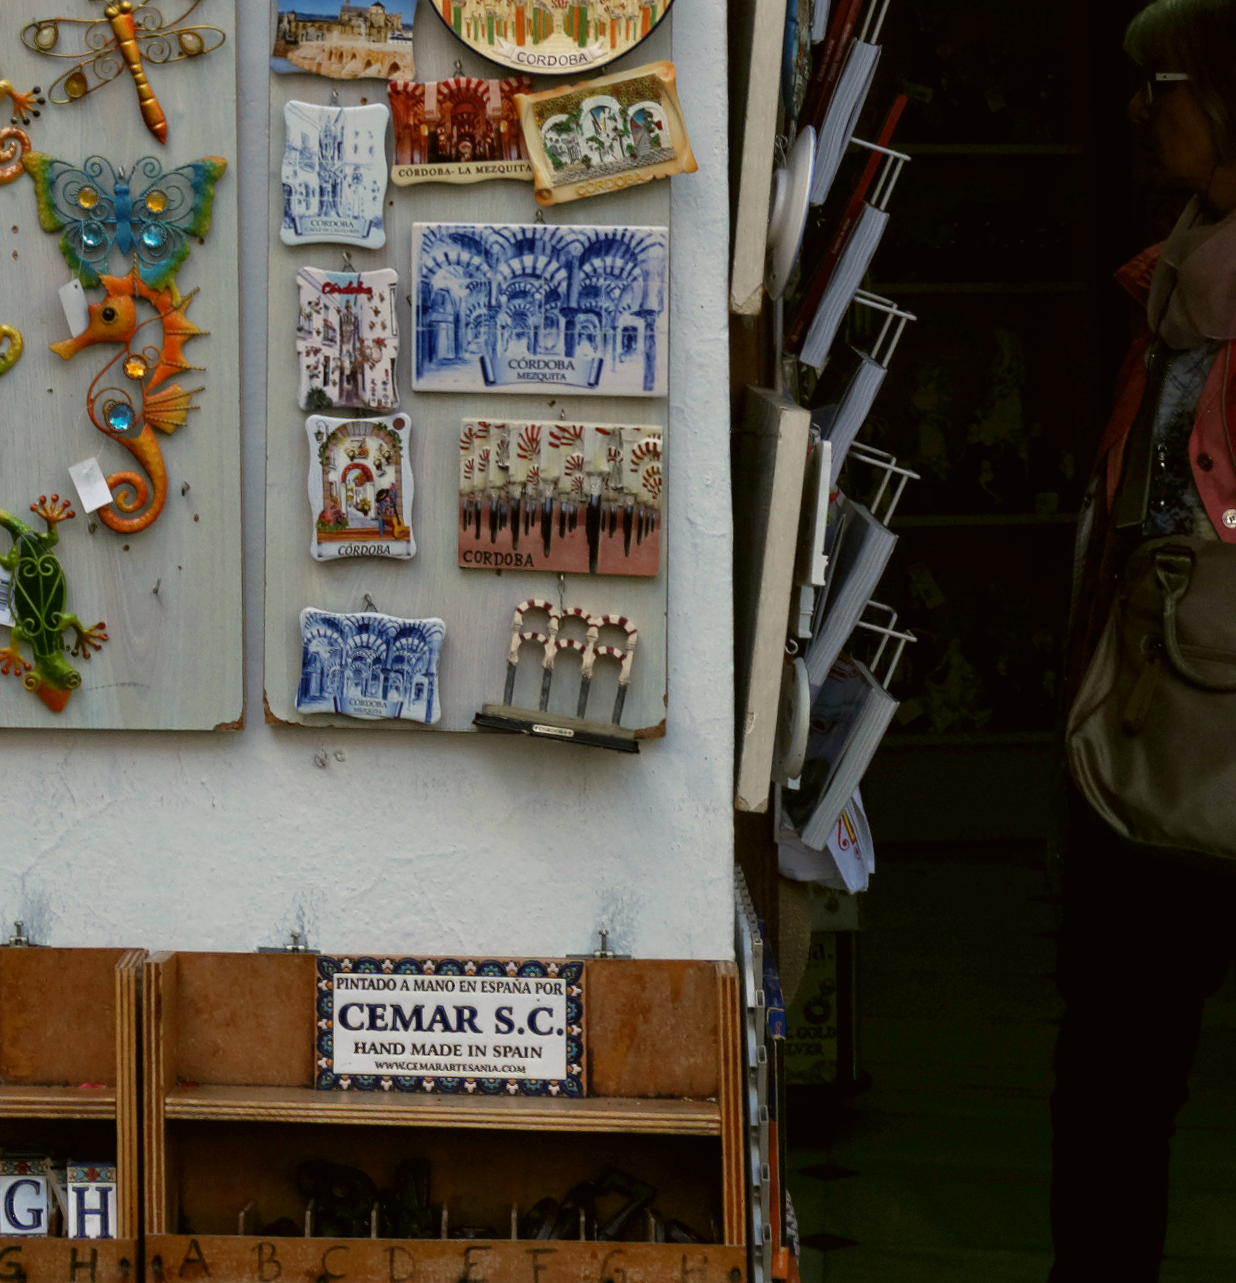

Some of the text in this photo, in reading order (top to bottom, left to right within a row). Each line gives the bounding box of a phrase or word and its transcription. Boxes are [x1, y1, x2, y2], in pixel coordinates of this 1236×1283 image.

[517, 52, 587, 66] CORDOBA
[458, 167, 471, 175] LA
[475, 163, 532, 174] MEZQUITA
[508, 357, 575, 370] CÓRDOBA
[517, 372, 566, 381] MEZQUITA
[338, 544, 391, 556] CÓRDOBA
[463, 550, 534, 567] CORDOBA
[336, 977, 563, 995] PINTADO A MANO EN ESPAÑA POR
[338, 1003, 564, 1036] CEMAR S.C.
[354, 1042, 542, 1059] HAND MADE IN SPAIN
[4, 1179, 44, 1230] G
[72, 1187, 113, 1238] H
